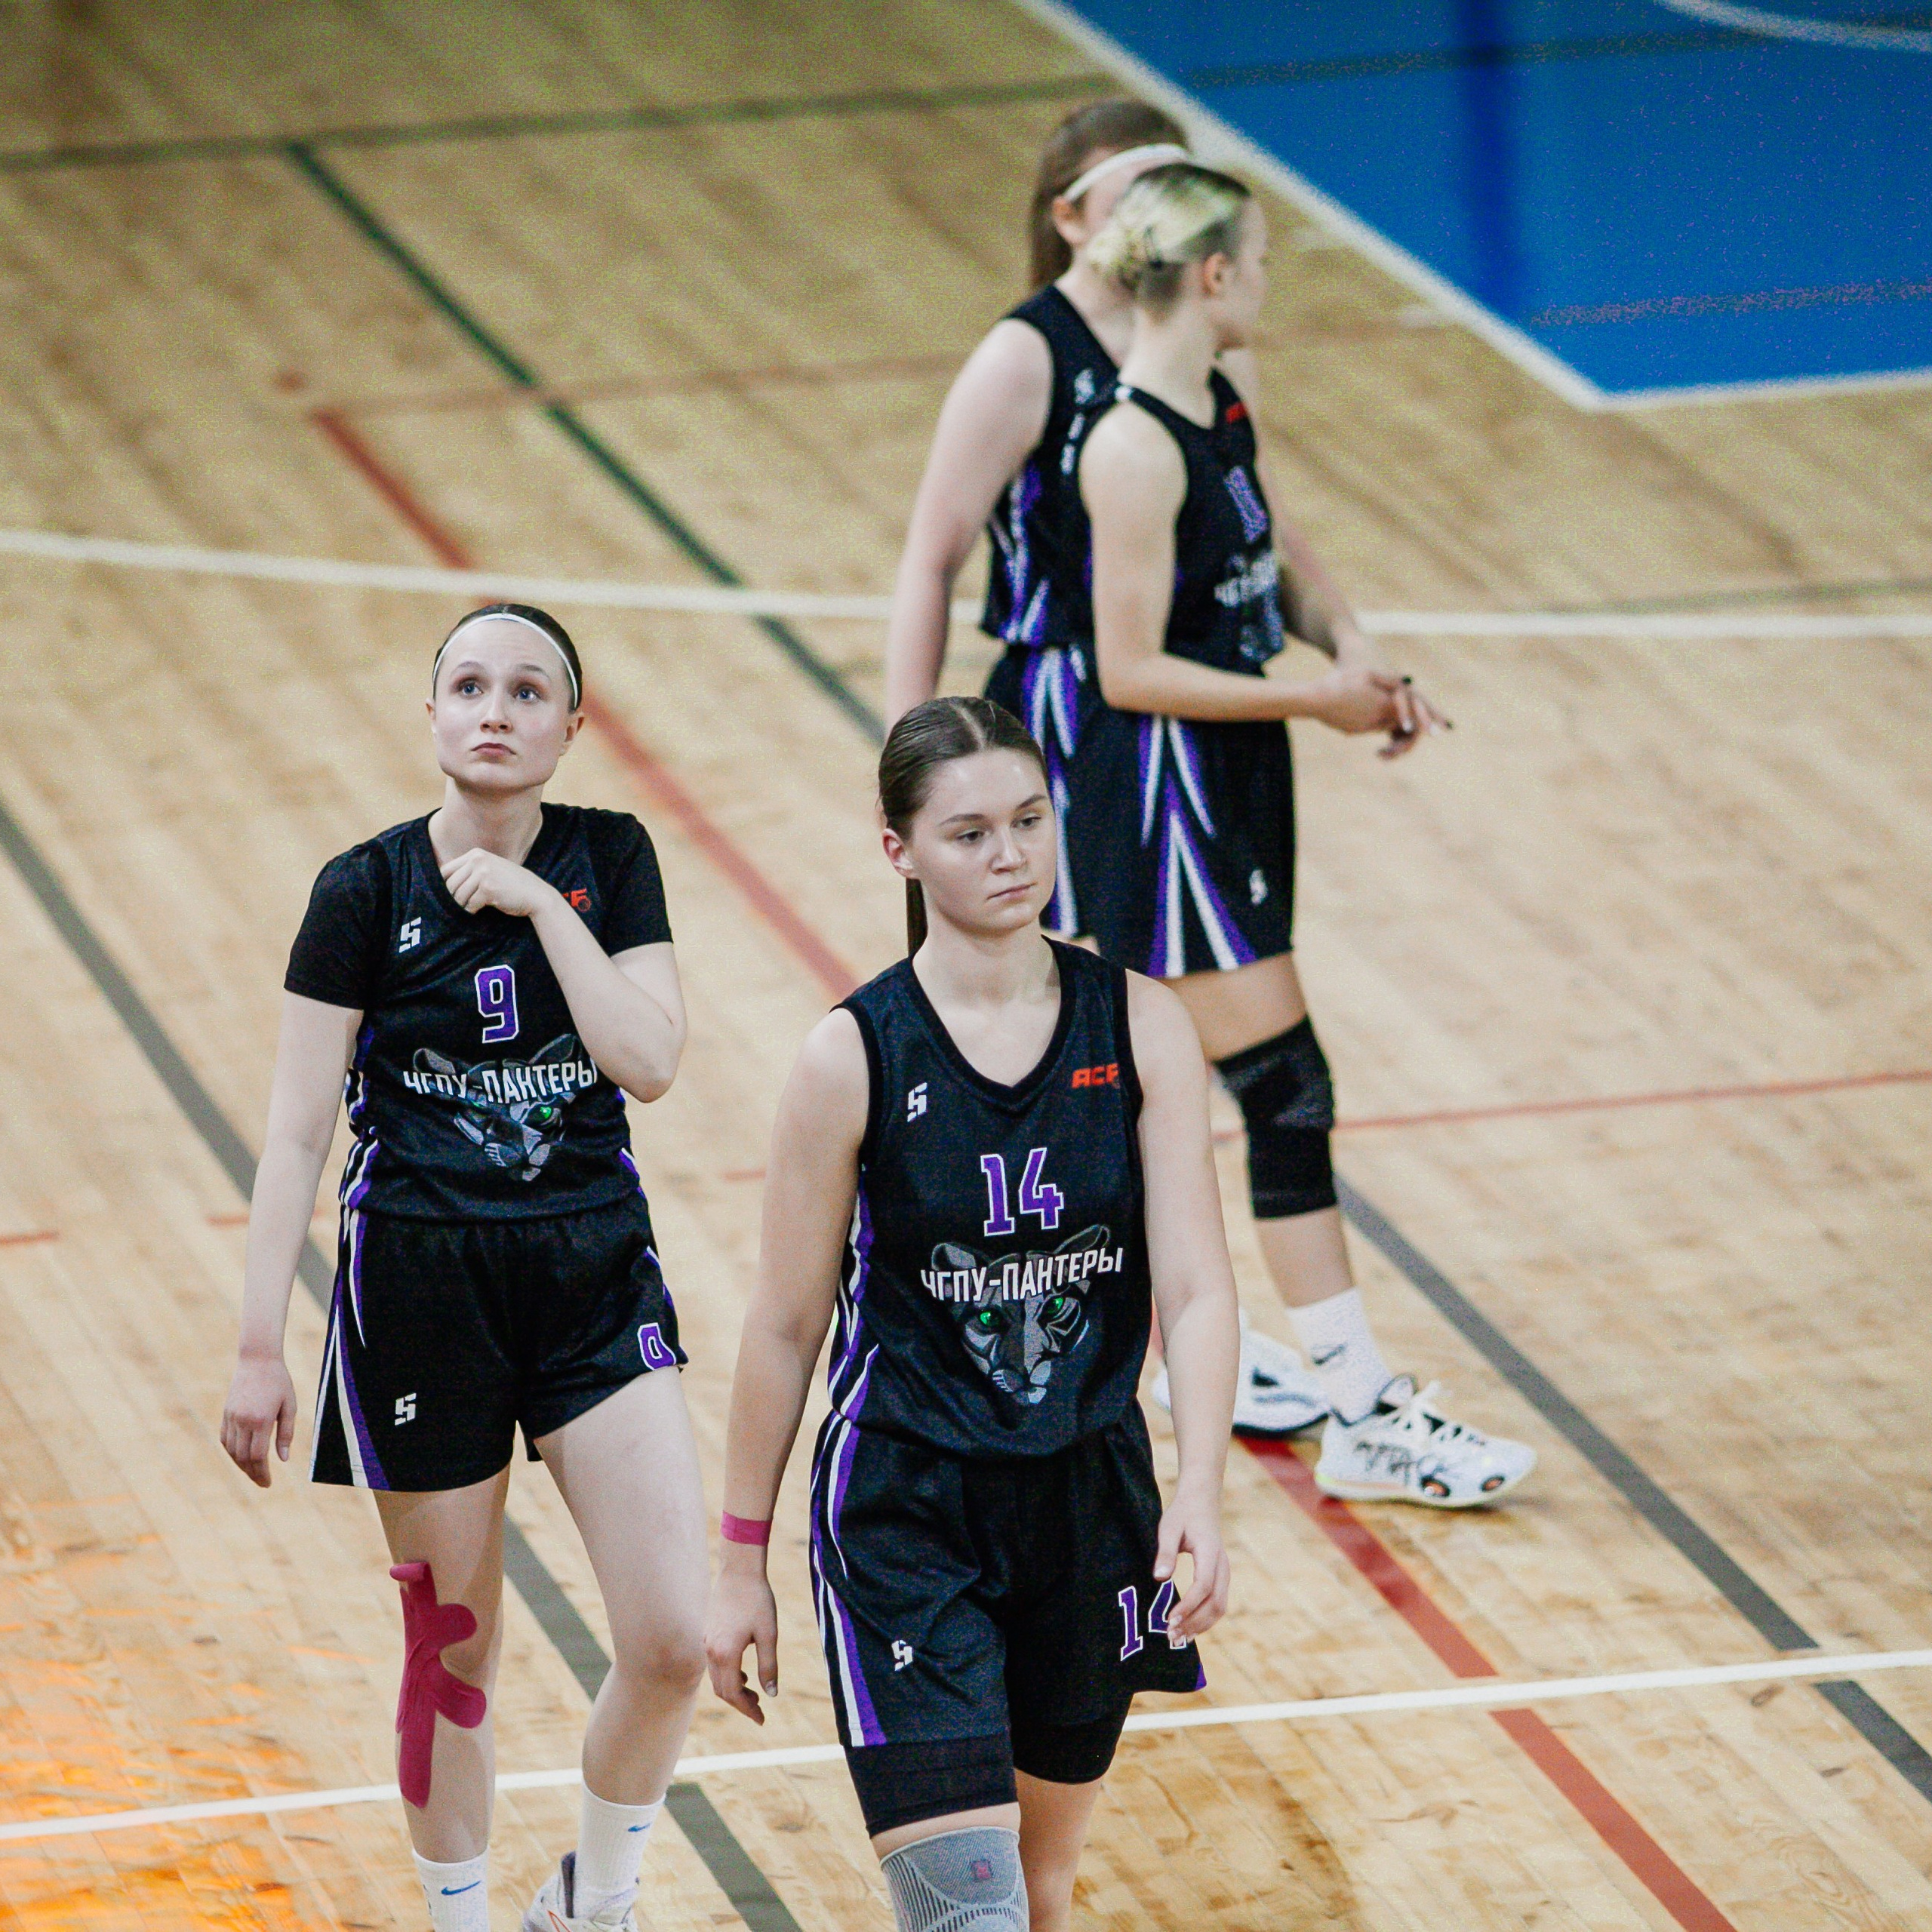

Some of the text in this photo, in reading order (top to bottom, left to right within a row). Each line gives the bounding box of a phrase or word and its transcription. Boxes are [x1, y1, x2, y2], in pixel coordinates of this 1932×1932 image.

[474, 964, 520, 1044] 9
[403, 1059, 598, 1104] ЧГПУ-ПАНТЕРЫ
[980, 1147, 1065, 1238] 14
[920, 1247, 1124, 1303] ЧГПУ-ПАНТЕРЫ
